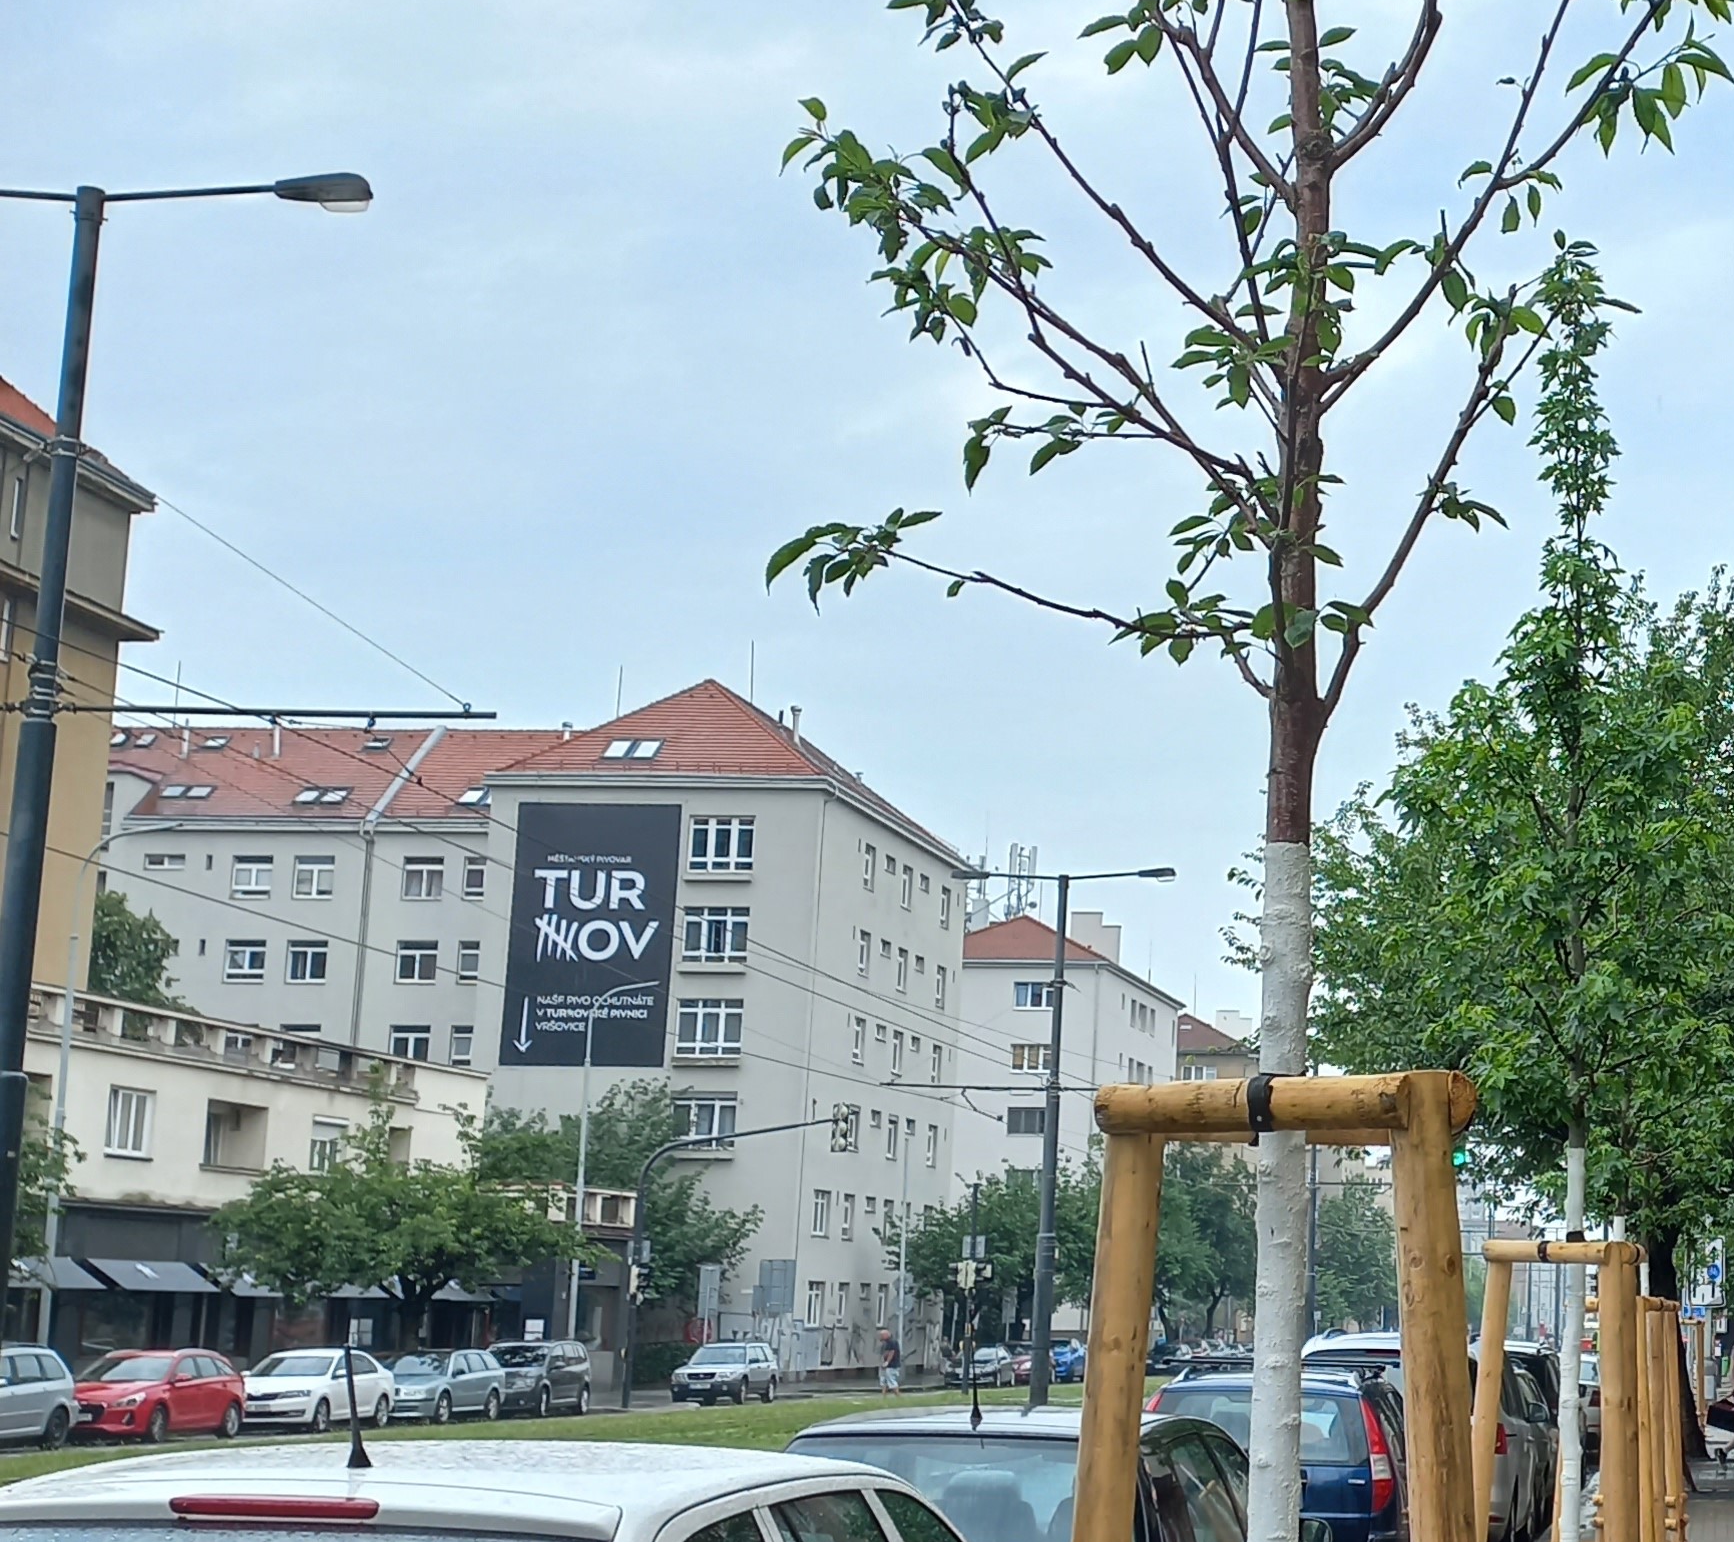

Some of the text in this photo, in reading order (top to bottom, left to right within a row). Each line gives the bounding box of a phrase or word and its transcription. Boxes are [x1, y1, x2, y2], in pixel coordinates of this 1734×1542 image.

[534, 869, 646, 910] TUR
[536, 994, 565, 1005] NAŠE
[567, 996, 591, 1005] PIVO
[535, 1020, 585, 1031] VRŠOVICE
